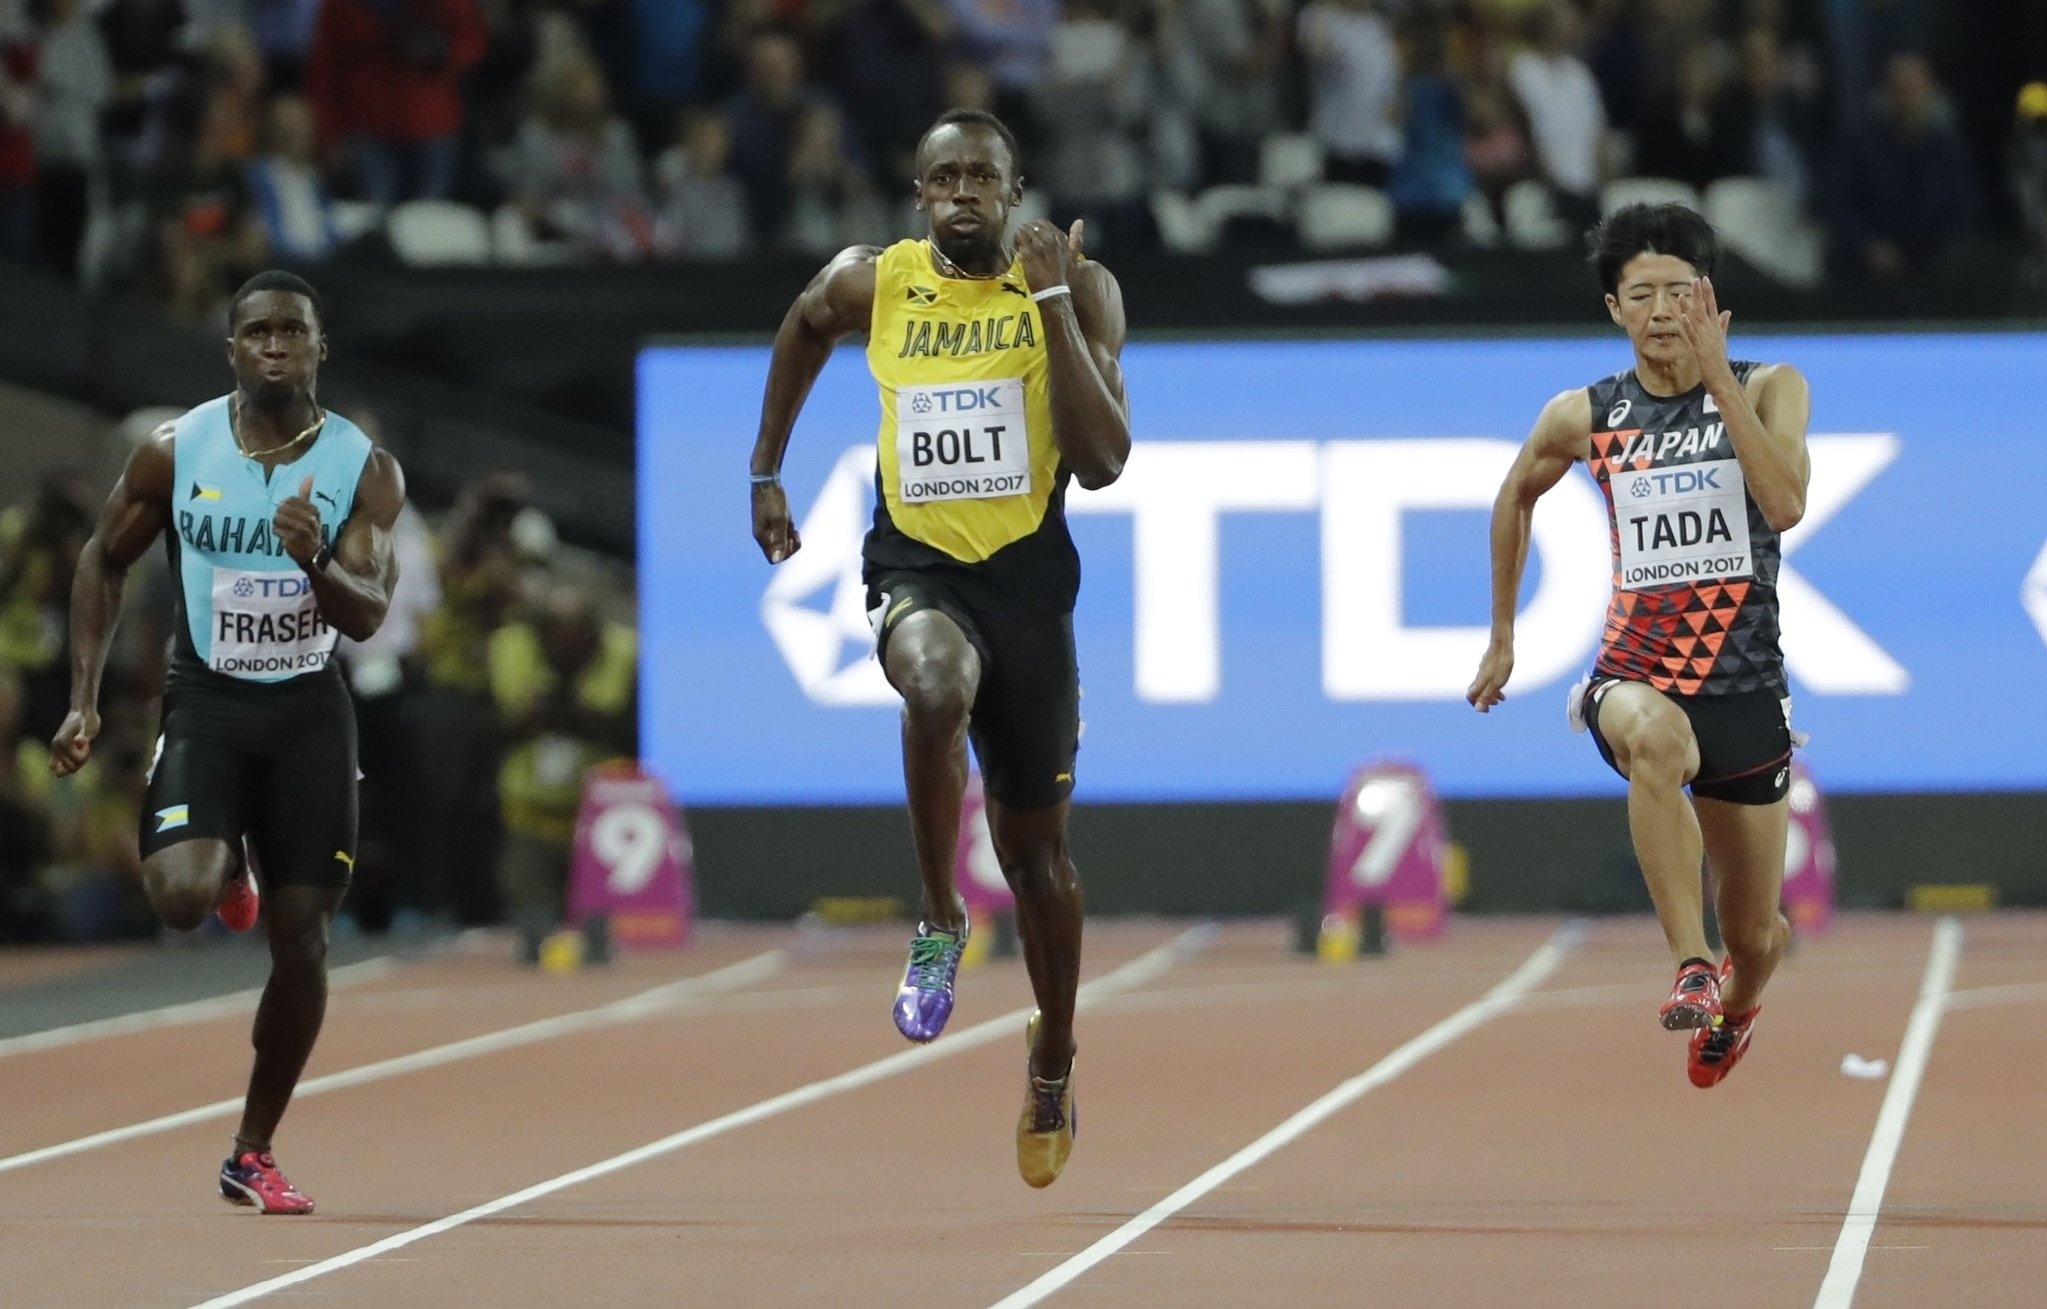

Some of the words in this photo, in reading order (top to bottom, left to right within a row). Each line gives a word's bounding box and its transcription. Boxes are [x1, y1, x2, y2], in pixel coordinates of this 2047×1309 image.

[898, 312, 1035, 358] JAMAICA
[932, 386, 1002, 412] TDK
[912, 425, 1006, 467] BOLT
[1612, 422, 1724, 466] JAPAN
[904, 481, 980, 498] LONDON
[982, 475, 1024, 493] 2017
[1650, 467, 1722, 496] TDK
[179, 510, 345, 557] BAHA
[1630, 507, 1732, 552] TADA
[1625, 560, 1699, 584] LONDON
[1702, 556, 1745, 574] 2017
[215, 657, 293, 673] LONDON
[590, 803, 665, 894] 9
[1351, 776, 1419, 887] 7
